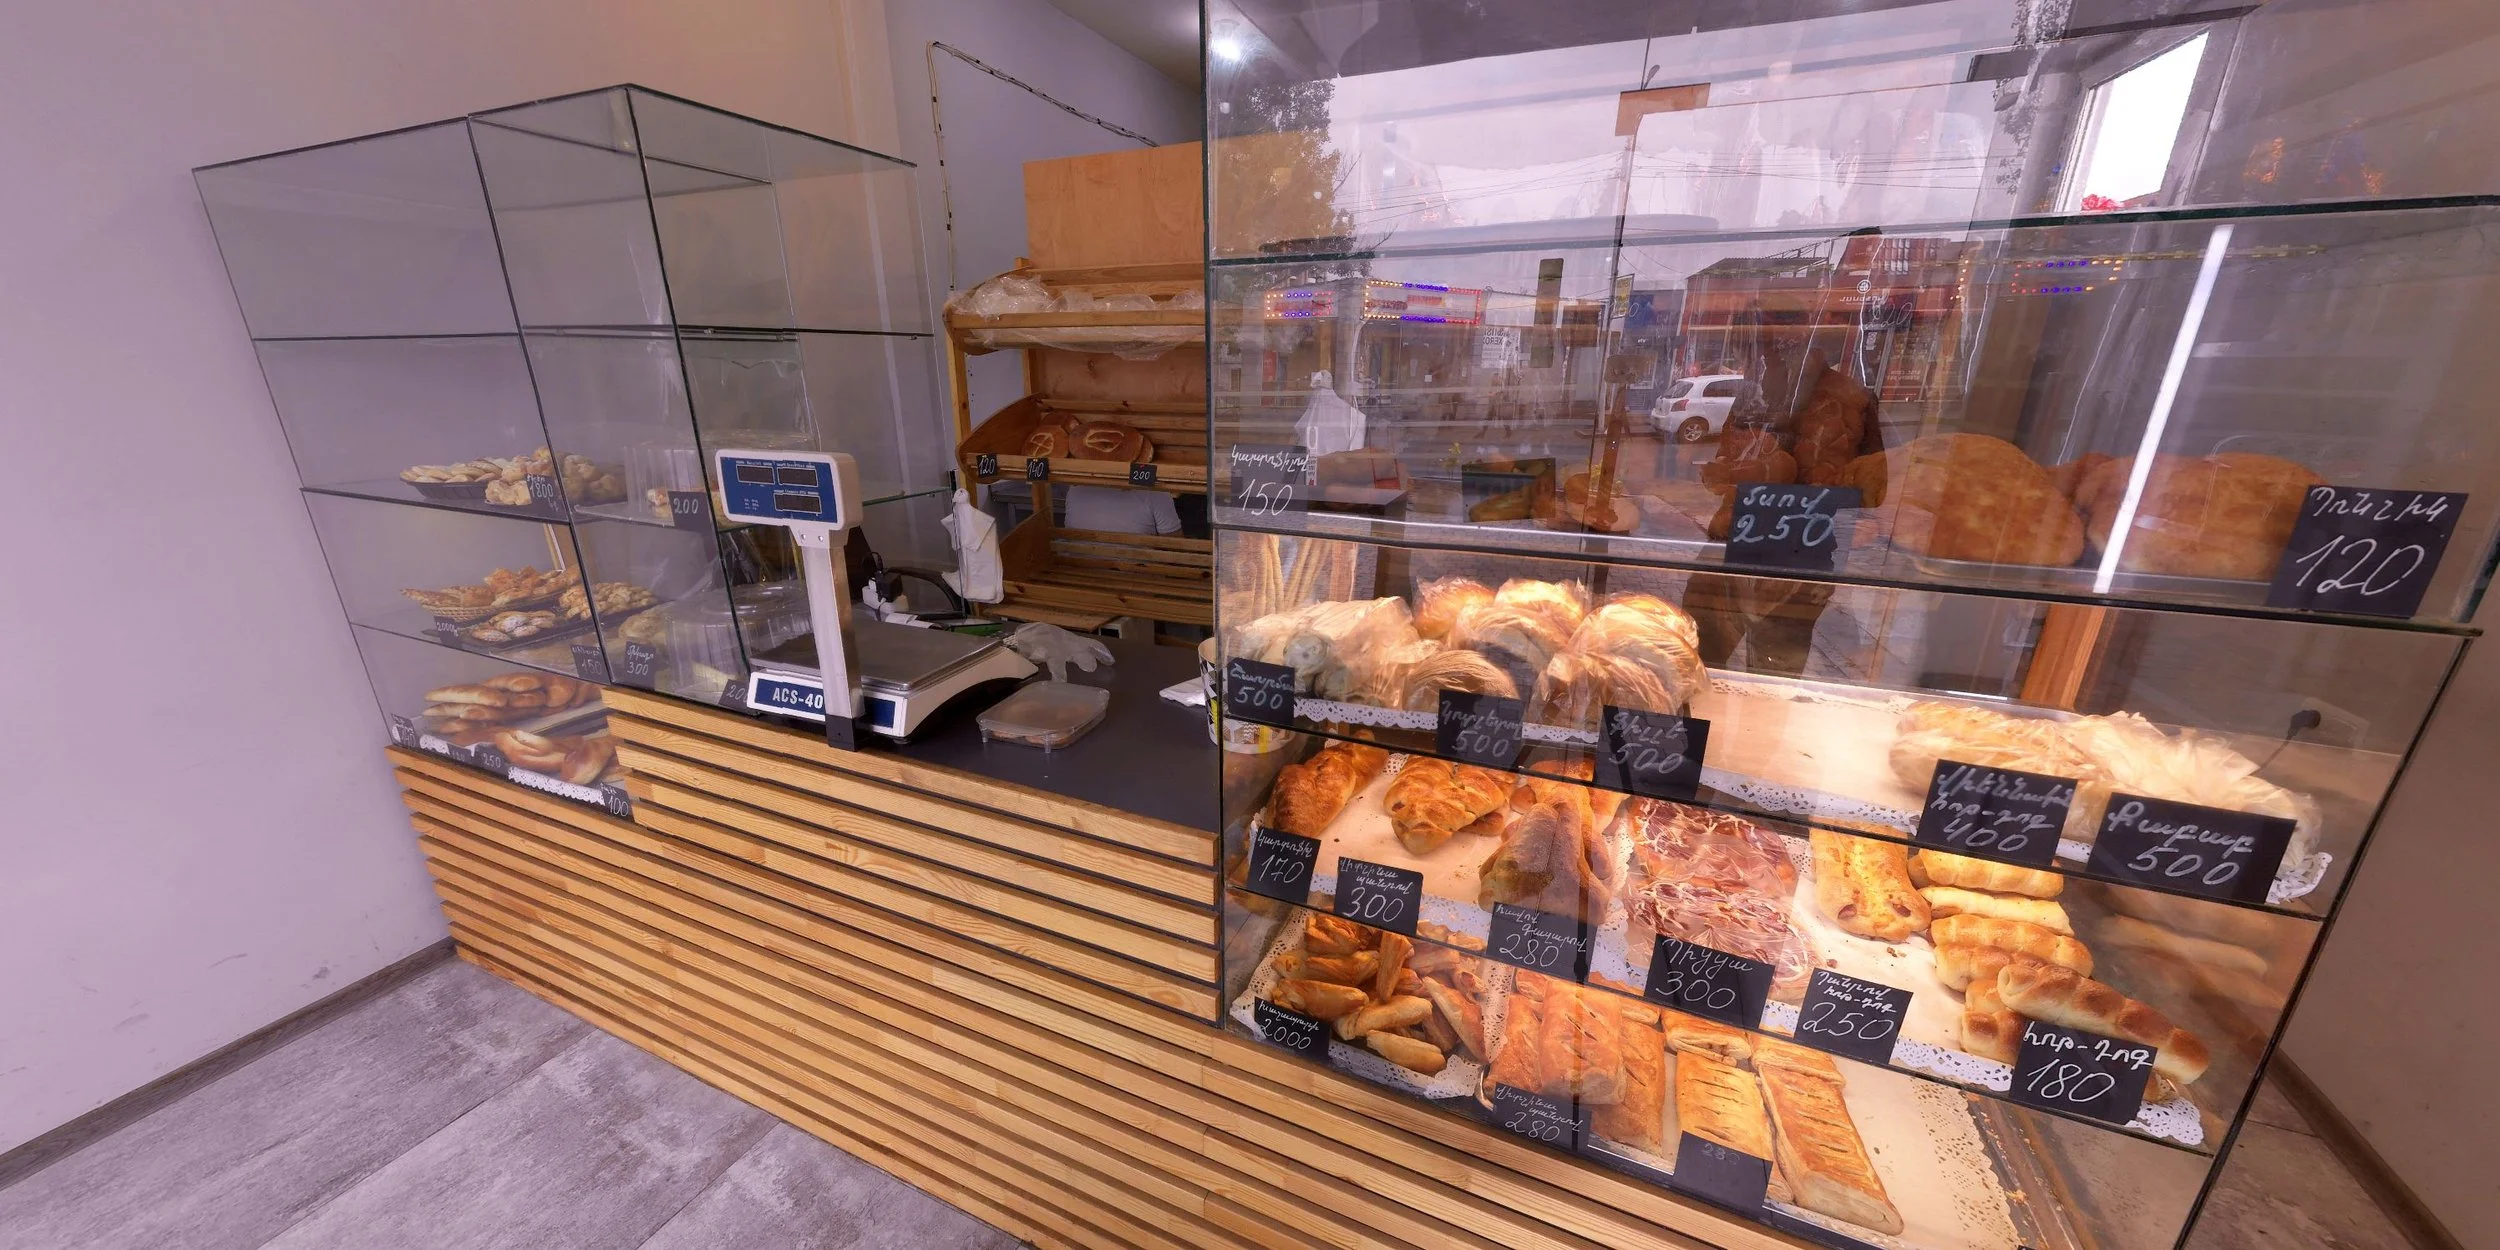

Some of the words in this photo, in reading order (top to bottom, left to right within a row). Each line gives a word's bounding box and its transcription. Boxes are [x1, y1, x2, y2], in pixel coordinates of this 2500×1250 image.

[979, 457, 996, 475] 120
[1028, 462, 1045, 478] 140
[1133, 470, 1151, 480] 200
[673, 498, 699, 514] 200
[1239, 479, 1293, 515] 150
[2310, 486, 2449, 522] Պոնչիկ
[1733, 514, 1835, 547] 250
[2296, 535, 2425, 595] 120
[627, 662, 649, 675] 300
[773, 681, 824, 709] ACS-40
[1235, 686, 1283, 709] 500
[1452, 730, 1509, 757] 500
[1608, 742, 1684, 774] 500
[609, 795, 629, 817] 100
[1943, 818, 2029, 851] 400
[1259, 854, 1305, 884] 170
[2127, 845, 2240, 885] 500
[1341, 886, 1404, 923] 300
[1499, 933, 1559, 967] 280
[1662, 938, 1753, 980] Պիցցա
[1655, 970, 1736, 1009] 300
[1260, 1018, 1312, 1049] 2000
[1802, 1001, 1894, 1039] 250
[2027, 1058, 2115, 1102] 180
[1504, 1111, 1560, 1141] 280
